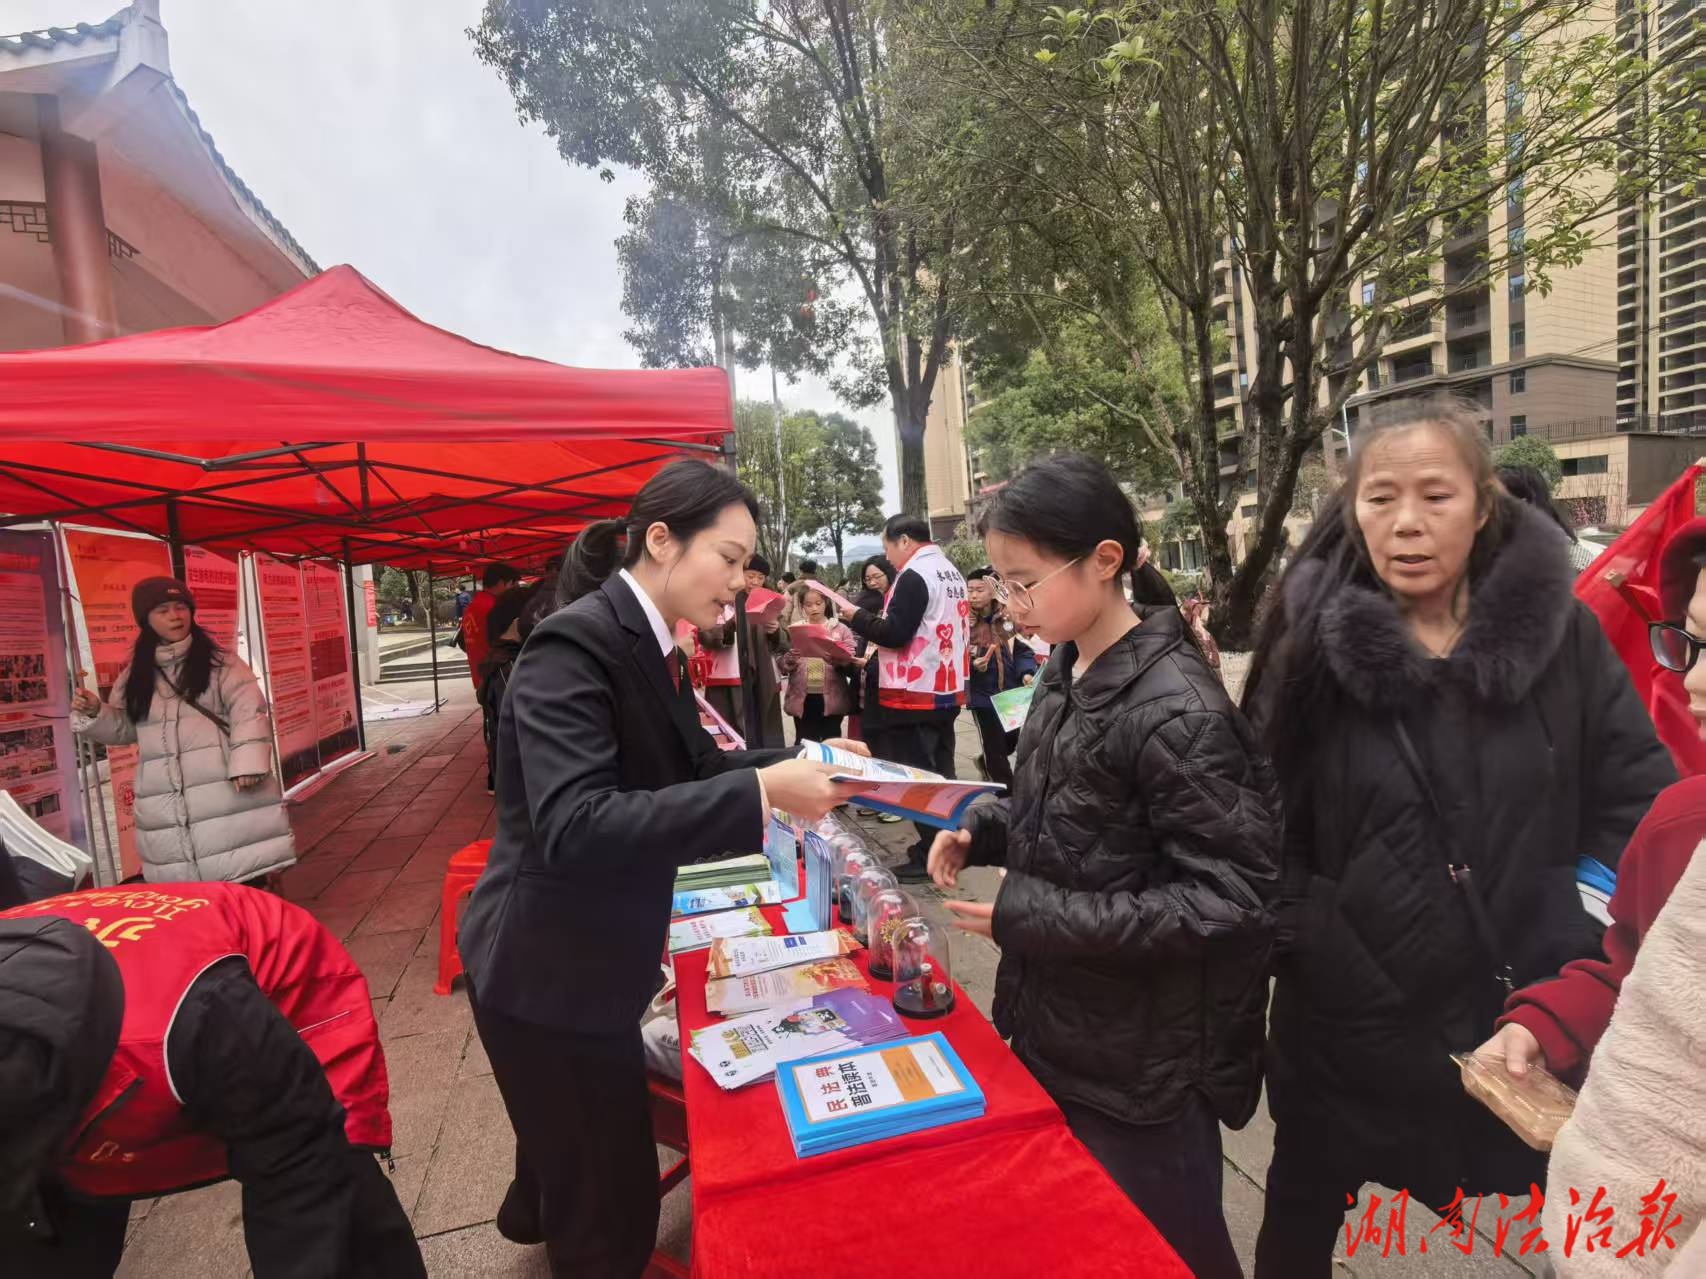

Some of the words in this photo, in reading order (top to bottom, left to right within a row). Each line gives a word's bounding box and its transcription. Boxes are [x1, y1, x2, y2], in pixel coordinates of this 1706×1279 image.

[816, 1066, 848, 1112] 民法典
[838, 1061, 872, 1107] 普法读本
